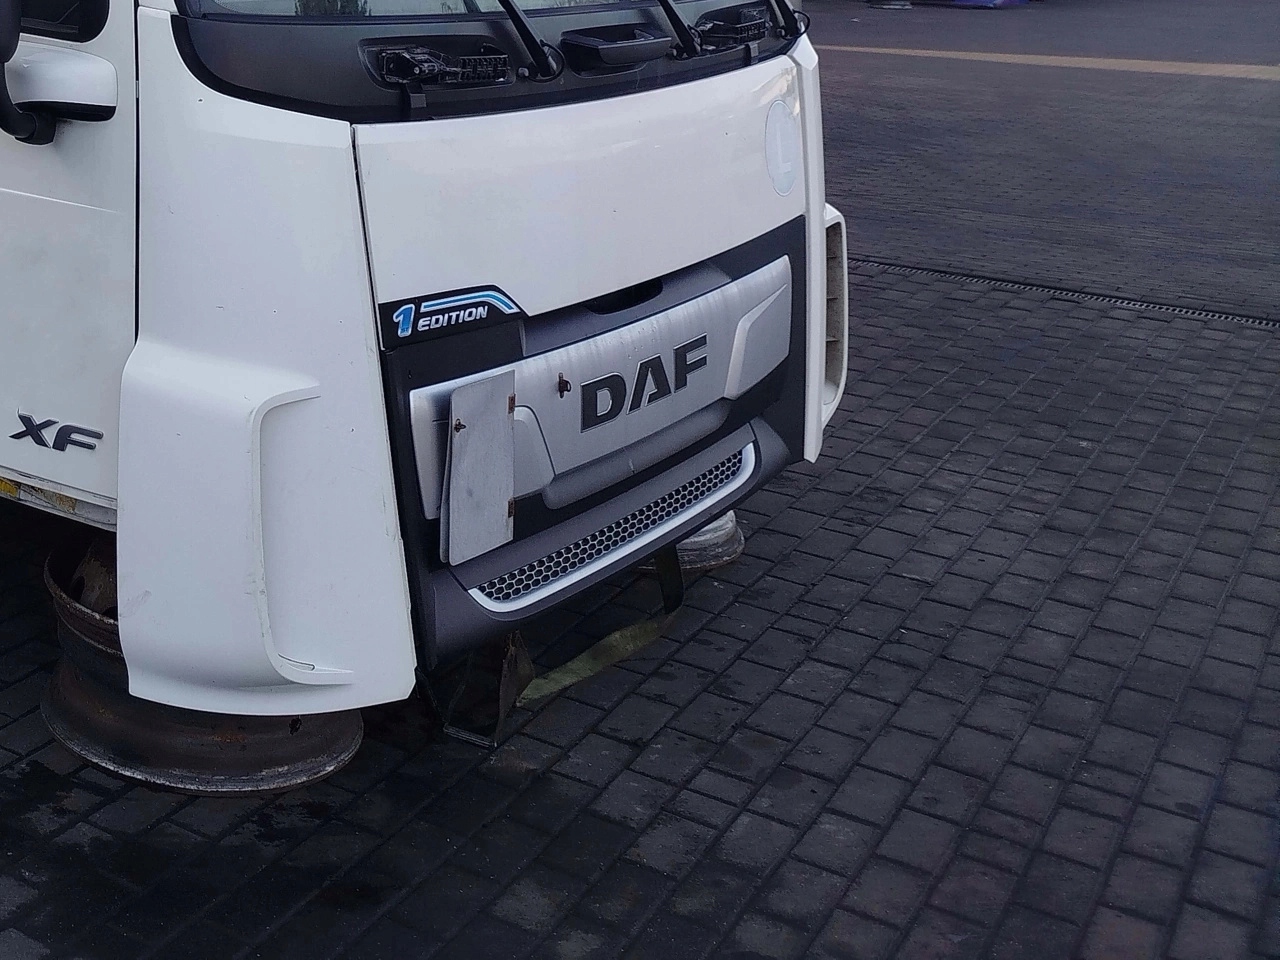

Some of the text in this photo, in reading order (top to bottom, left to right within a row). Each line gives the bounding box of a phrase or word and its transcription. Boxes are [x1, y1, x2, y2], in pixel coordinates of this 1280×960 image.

[417, 305, 488, 331] EDITION
[580, 332, 708, 434] DAF
[8, 412, 105, 452] XF
